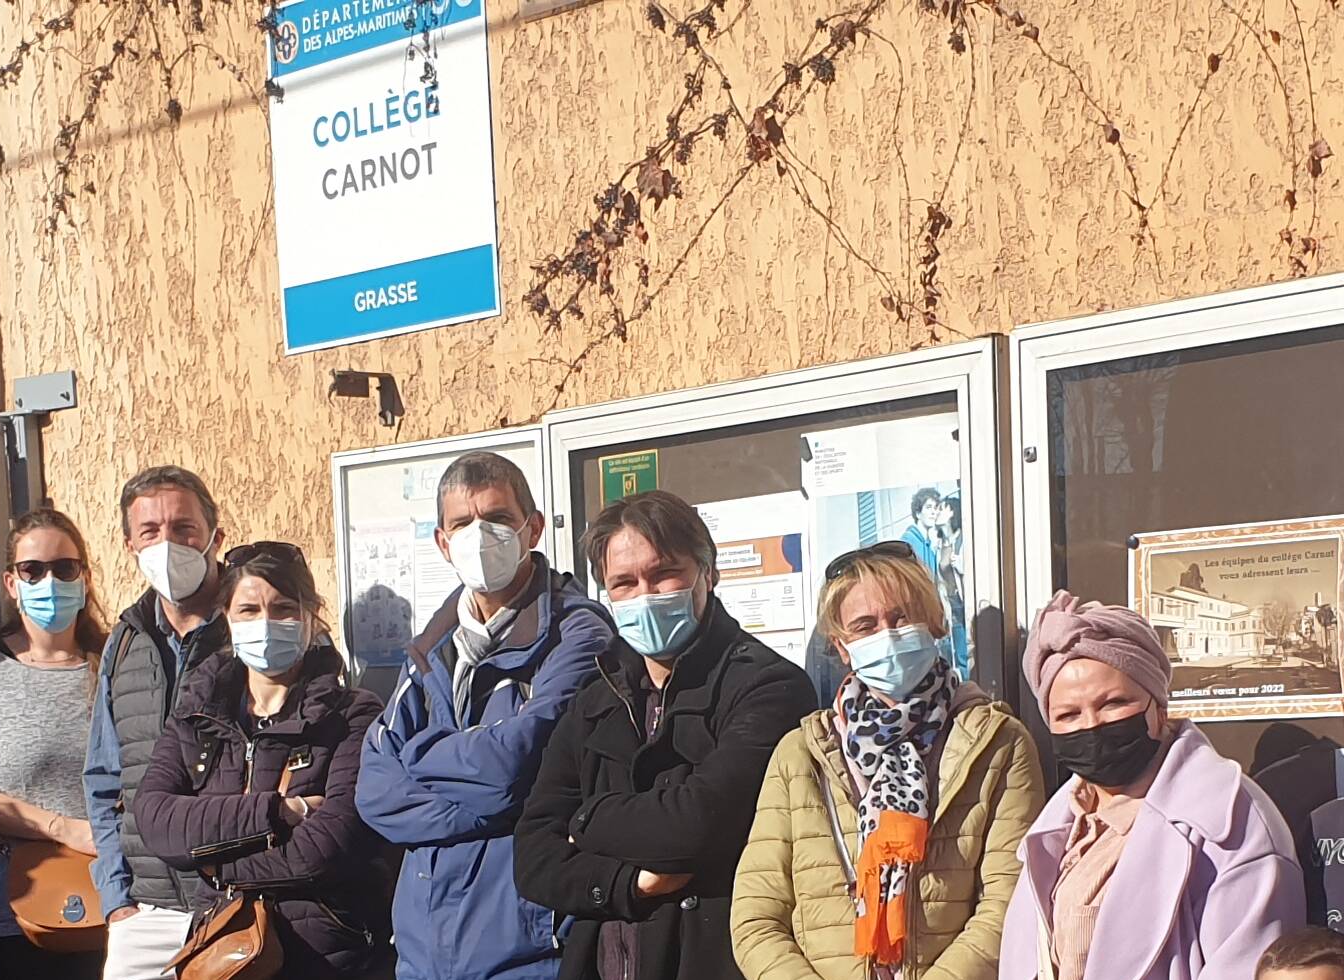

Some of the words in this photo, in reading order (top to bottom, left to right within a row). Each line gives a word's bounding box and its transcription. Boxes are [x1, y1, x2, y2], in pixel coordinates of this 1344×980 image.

[302, 35, 321, 53] DES
[313, 84, 441, 148] COLLÈGE
[322, 141, 438, 200] CARNOT
[354, 280, 419, 312] GRASSE
[1205, 559, 1219, 568] Les
[1221, 555, 1256, 567] équipes
[1258, 554, 1270, 564] du
[1271, 551, 1303, 563] collège
[1305, 549, 1335, 560] Carnot
[1242, 569, 1284, 579] adressent
[1286, 567, 1309, 576] leurs
[1239, 686, 1259, 696] pour
[1261, 684, 1285, 693] 2022
